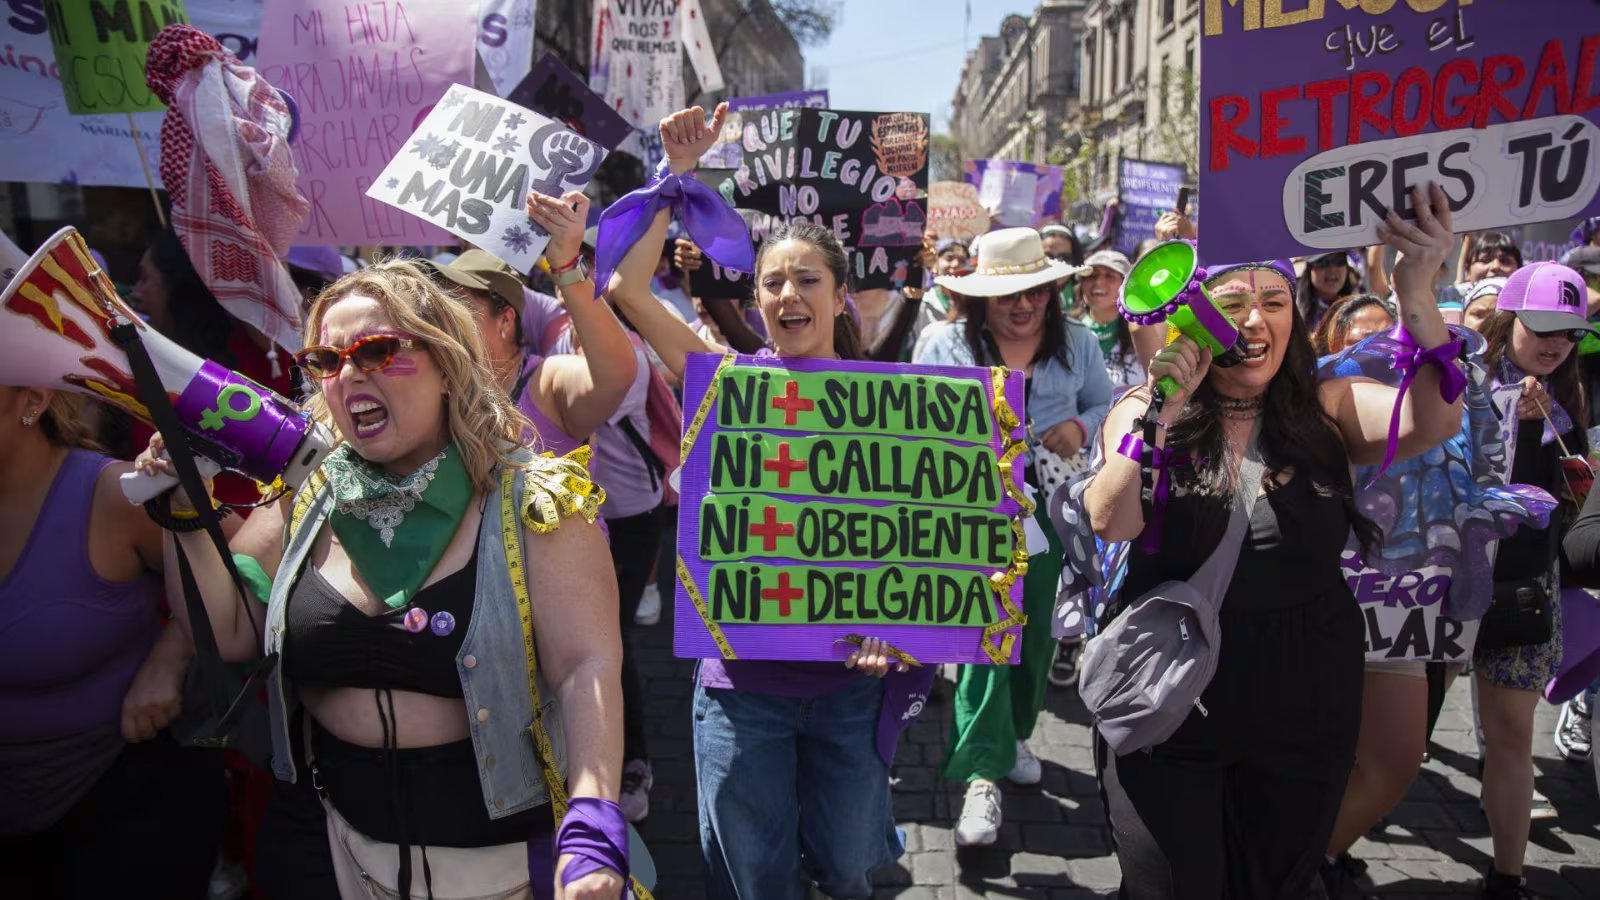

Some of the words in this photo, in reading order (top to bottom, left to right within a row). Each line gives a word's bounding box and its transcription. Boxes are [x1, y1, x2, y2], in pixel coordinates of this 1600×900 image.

[293, 10, 326, 46] MI
[344, 1, 416, 44] HIJA
[1326, 23, 1402, 70] que
[448, 100, 506, 142] NI
[743, 111, 794, 152] QUE
[817, 112, 862, 149] TU
[397, 171, 494, 234] MAS
[449, 148, 530, 210] UNA
[779, 184, 820, 216] NO
[1304, 142, 1475, 233] ERES
[1508, 122, 1589, 208] TÚ
[809, 439, 997, 503] CALLADA
[807, 566, 993, 624] DELGADA
